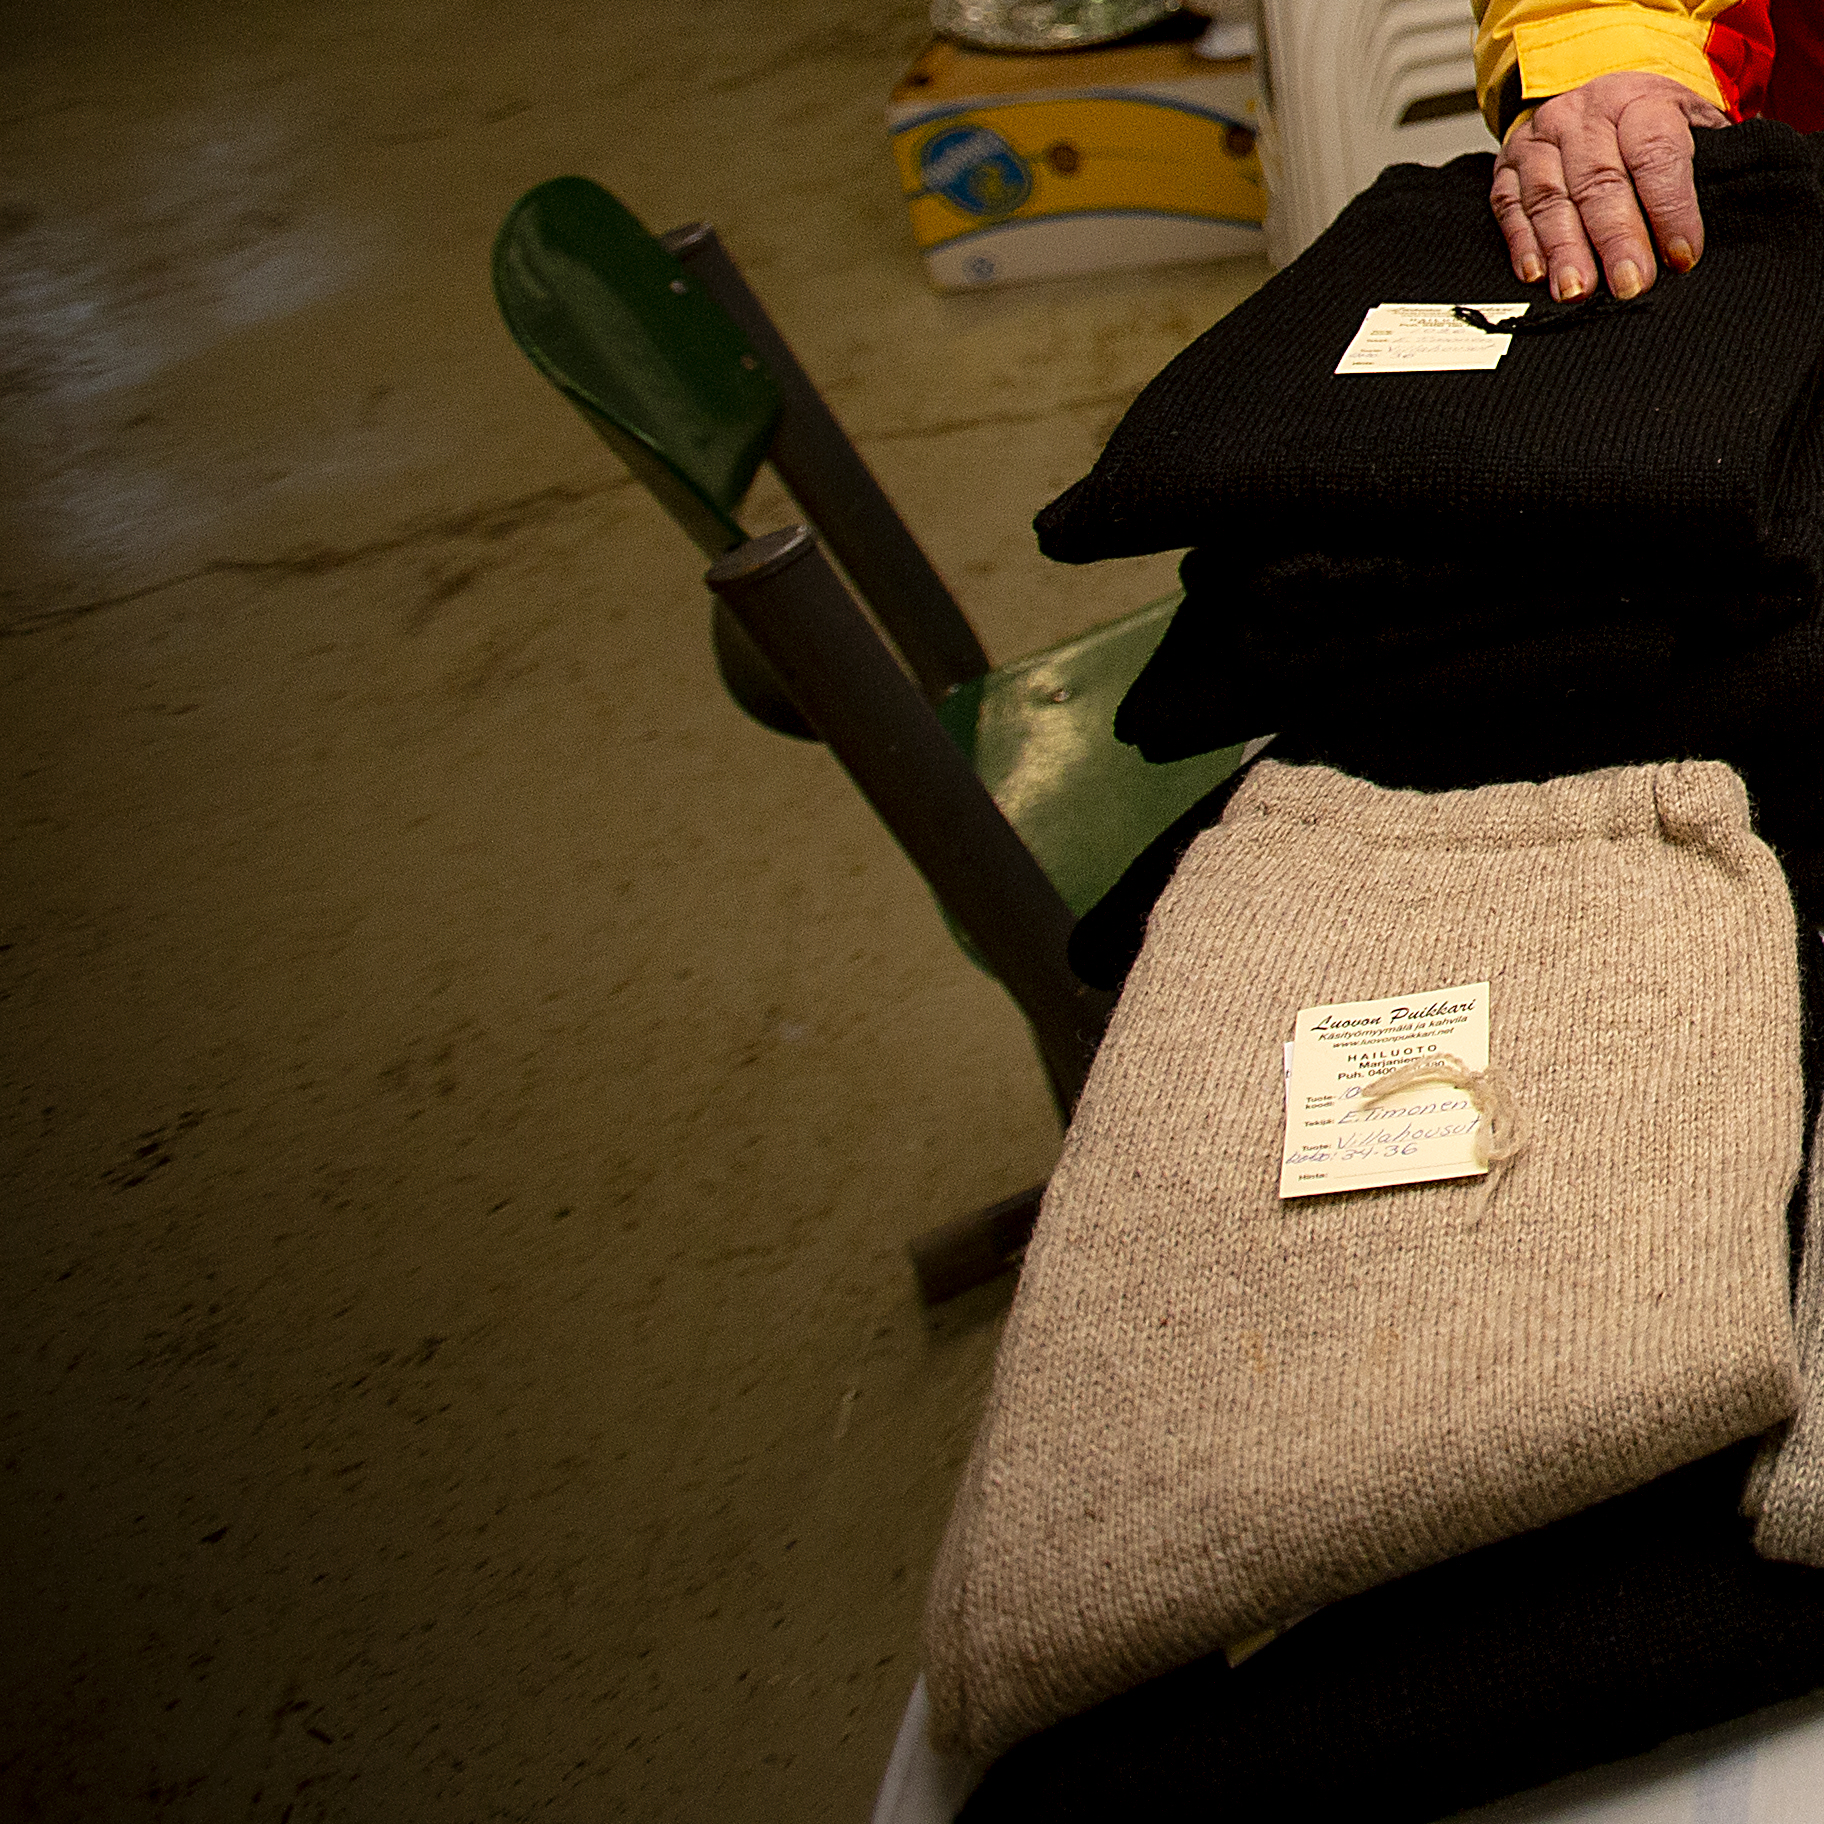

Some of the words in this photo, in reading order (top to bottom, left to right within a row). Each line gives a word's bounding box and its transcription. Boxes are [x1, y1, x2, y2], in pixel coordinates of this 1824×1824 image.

[1310, 1015, 1382, 1032] Luovon
[1389, 998, 1477, 1025] Puikkari
[1317, 1022, 1413, 1042] Käsityömyymälä
[1415, 1021, 1426, 1032] ja
[1429, 1015, 1469, 1028] kahvila
[1332, 1026, 1456, 1049] www.luovonpuikkari.net
[1347, 1044, 1437, 1063] HAILUOTO
[1338, 1071, 1365, 1081] Puh.
